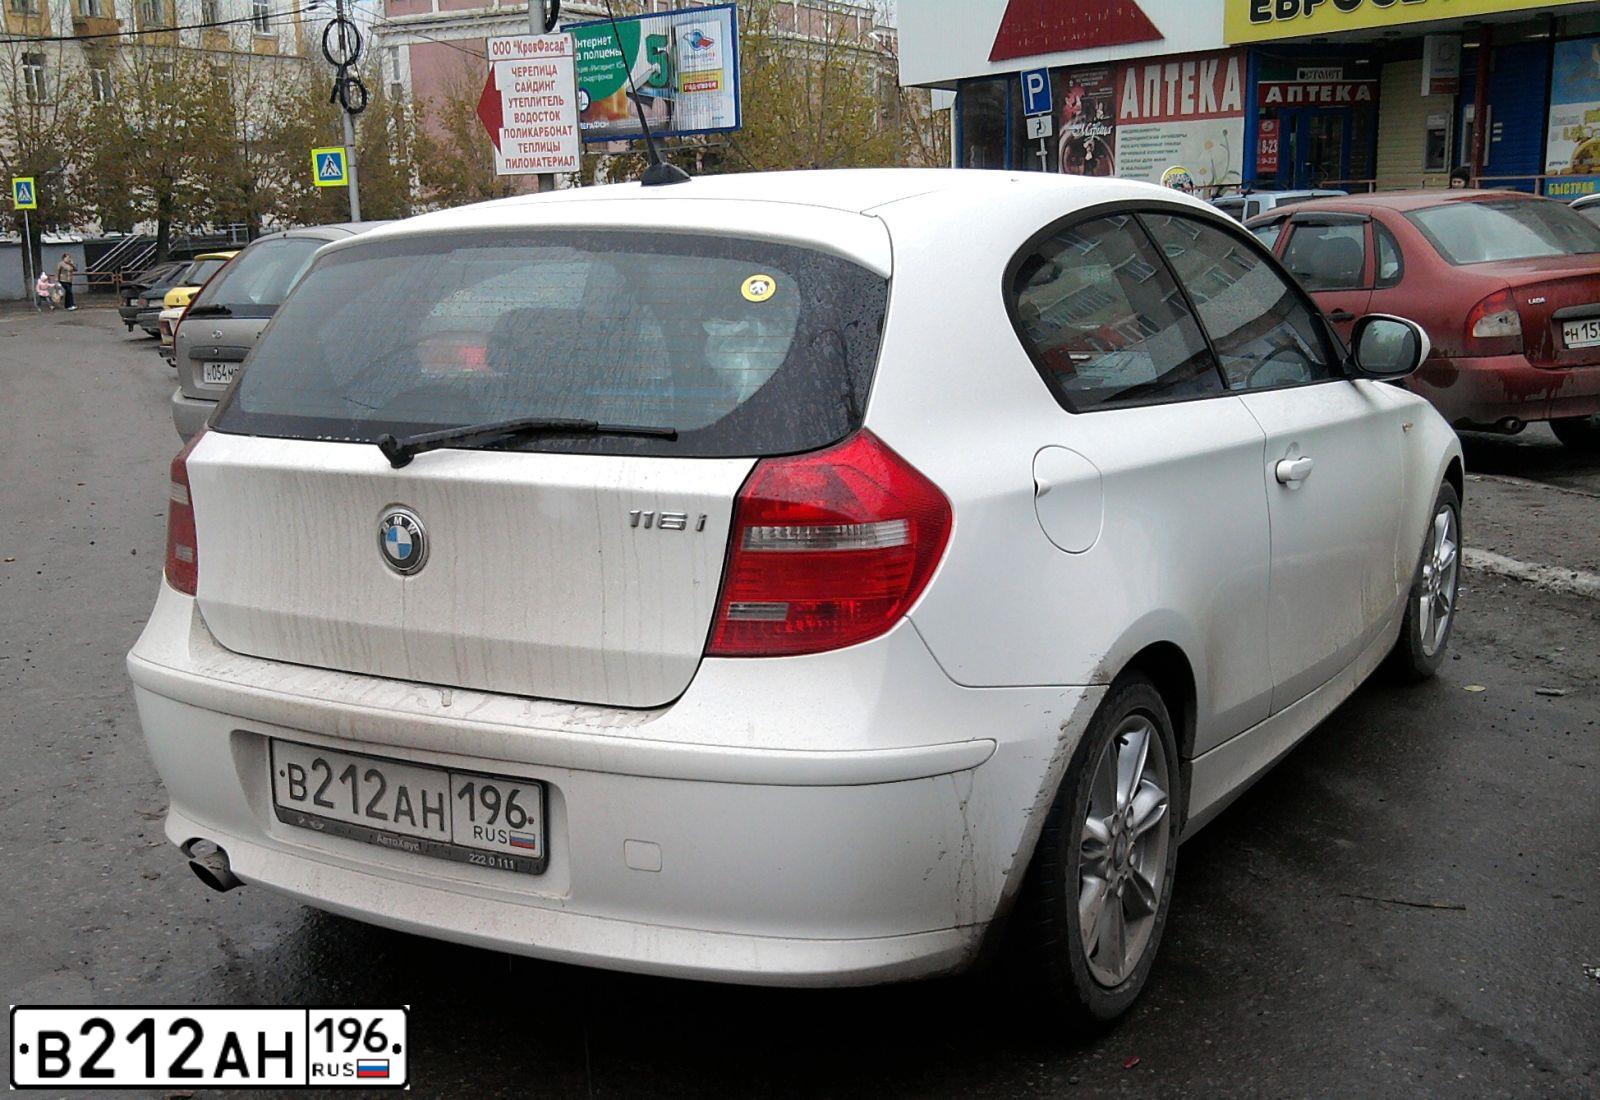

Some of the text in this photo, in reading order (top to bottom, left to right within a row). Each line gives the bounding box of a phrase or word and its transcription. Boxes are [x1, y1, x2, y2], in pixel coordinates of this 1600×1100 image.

[492, 41, 512, 55] ООО
[511, 64, 558, 77] ЧЕРЕПИЦА
[514, 79, 556, 93] САЙДИНГ
[1119, 55, 1243, 120] АПТЕКА
[1264, 84, 1372, 103] АПТЕКА
[508, 95, 565, 108] УТЕПЛИТЕЛЬ
[513, 110, 561, 124] ВОДОСТОК
[503, 125, 573, 139] ПОЛИКАРБОНАТ
[517, 141, 561, 154] ТЕПЛИЦЫ
[505, 155, 576, 170] ПИЛОМАТЕРИАЛ
[1570, 321, 1600, 341] Н15
[382, 516, 419, 535] BMW
[457, 781, 528, 829] 196
[473, 825, 508, 845] RUS
